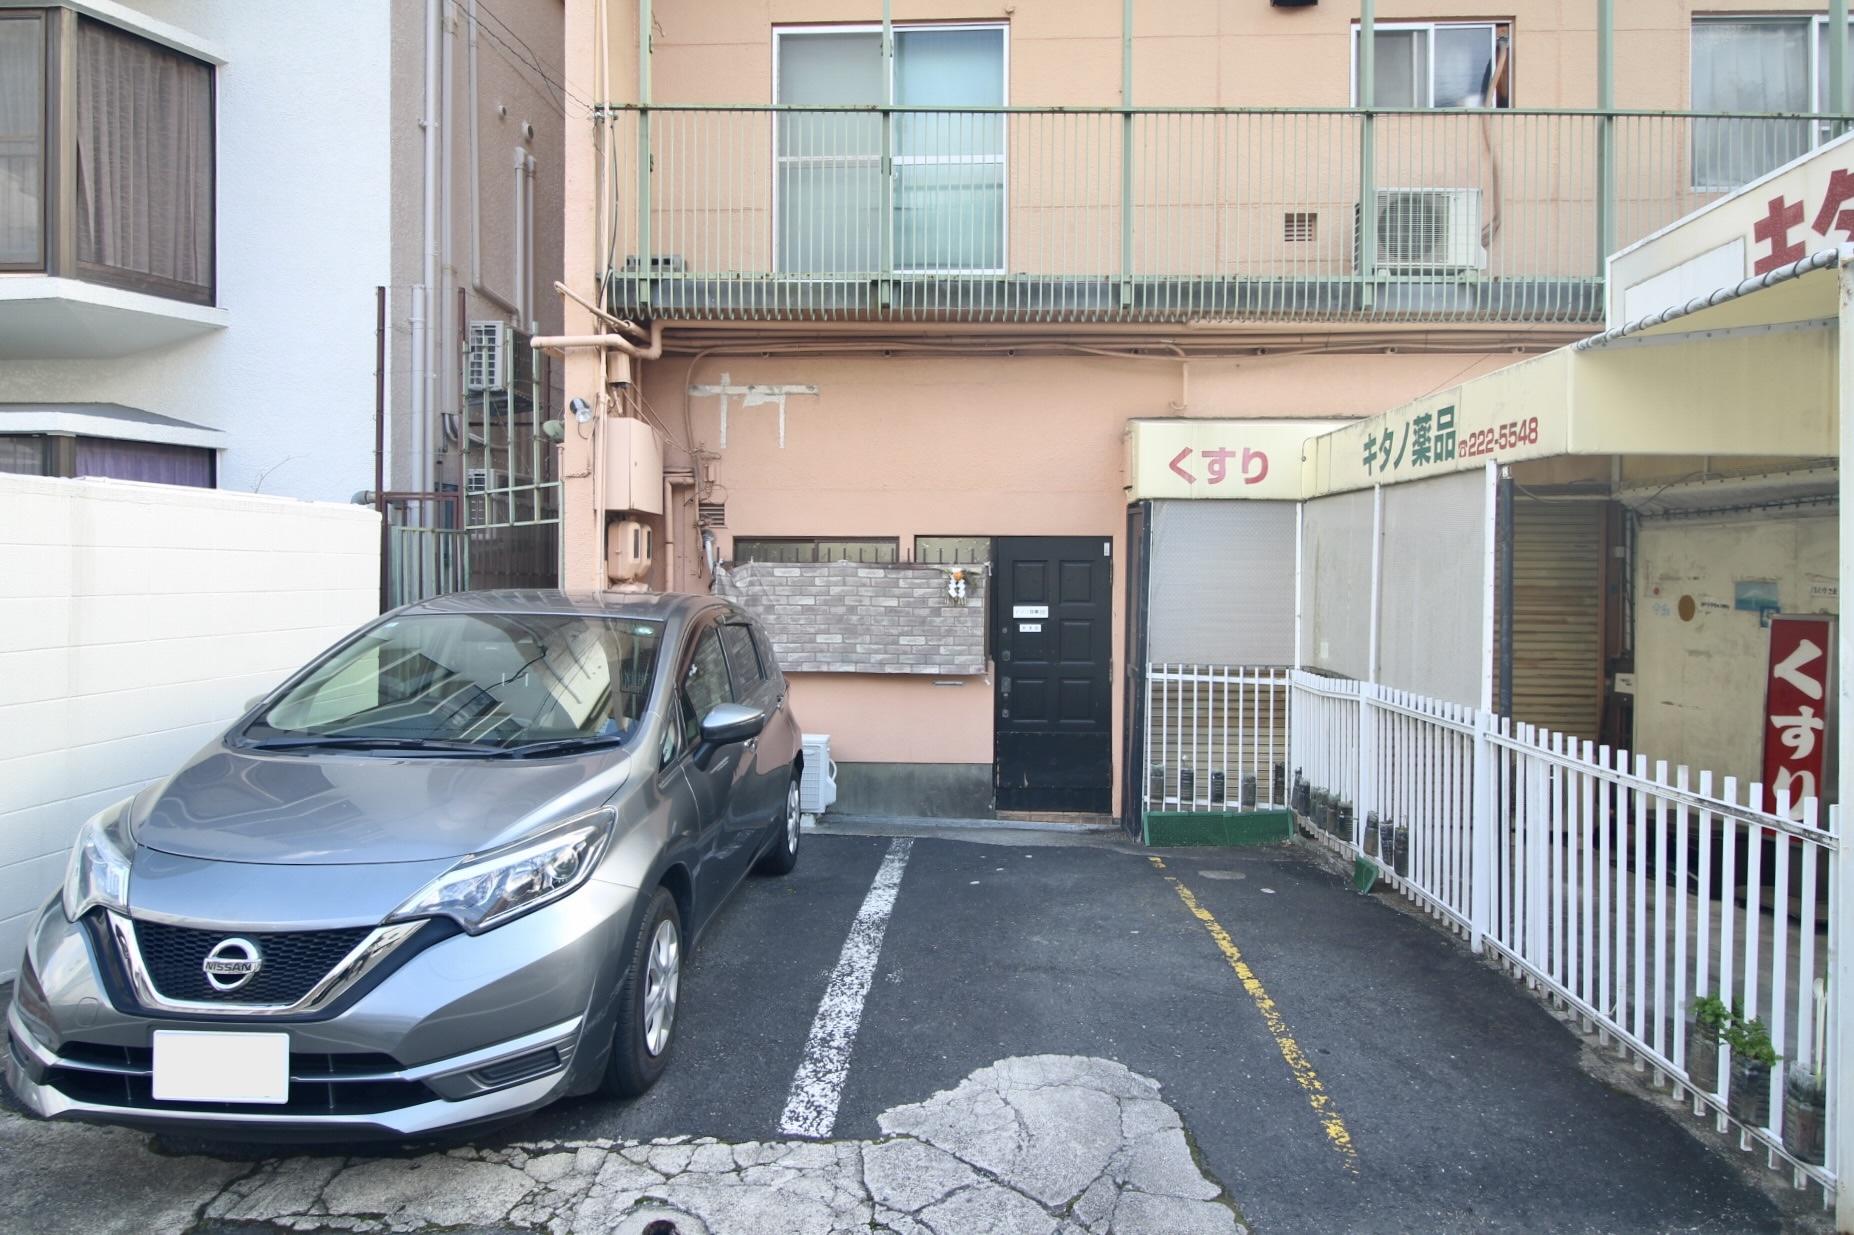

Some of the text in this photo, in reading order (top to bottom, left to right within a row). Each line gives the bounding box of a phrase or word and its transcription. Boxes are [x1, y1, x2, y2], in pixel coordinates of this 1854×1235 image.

[1168, 446, 1270, 485] くすり
[1362, 405, 1539, 476] キタノ薬品 222-5548
[1769, 638, 1825, 821] くすり
[205, 961, 252, 972] NISSAN
